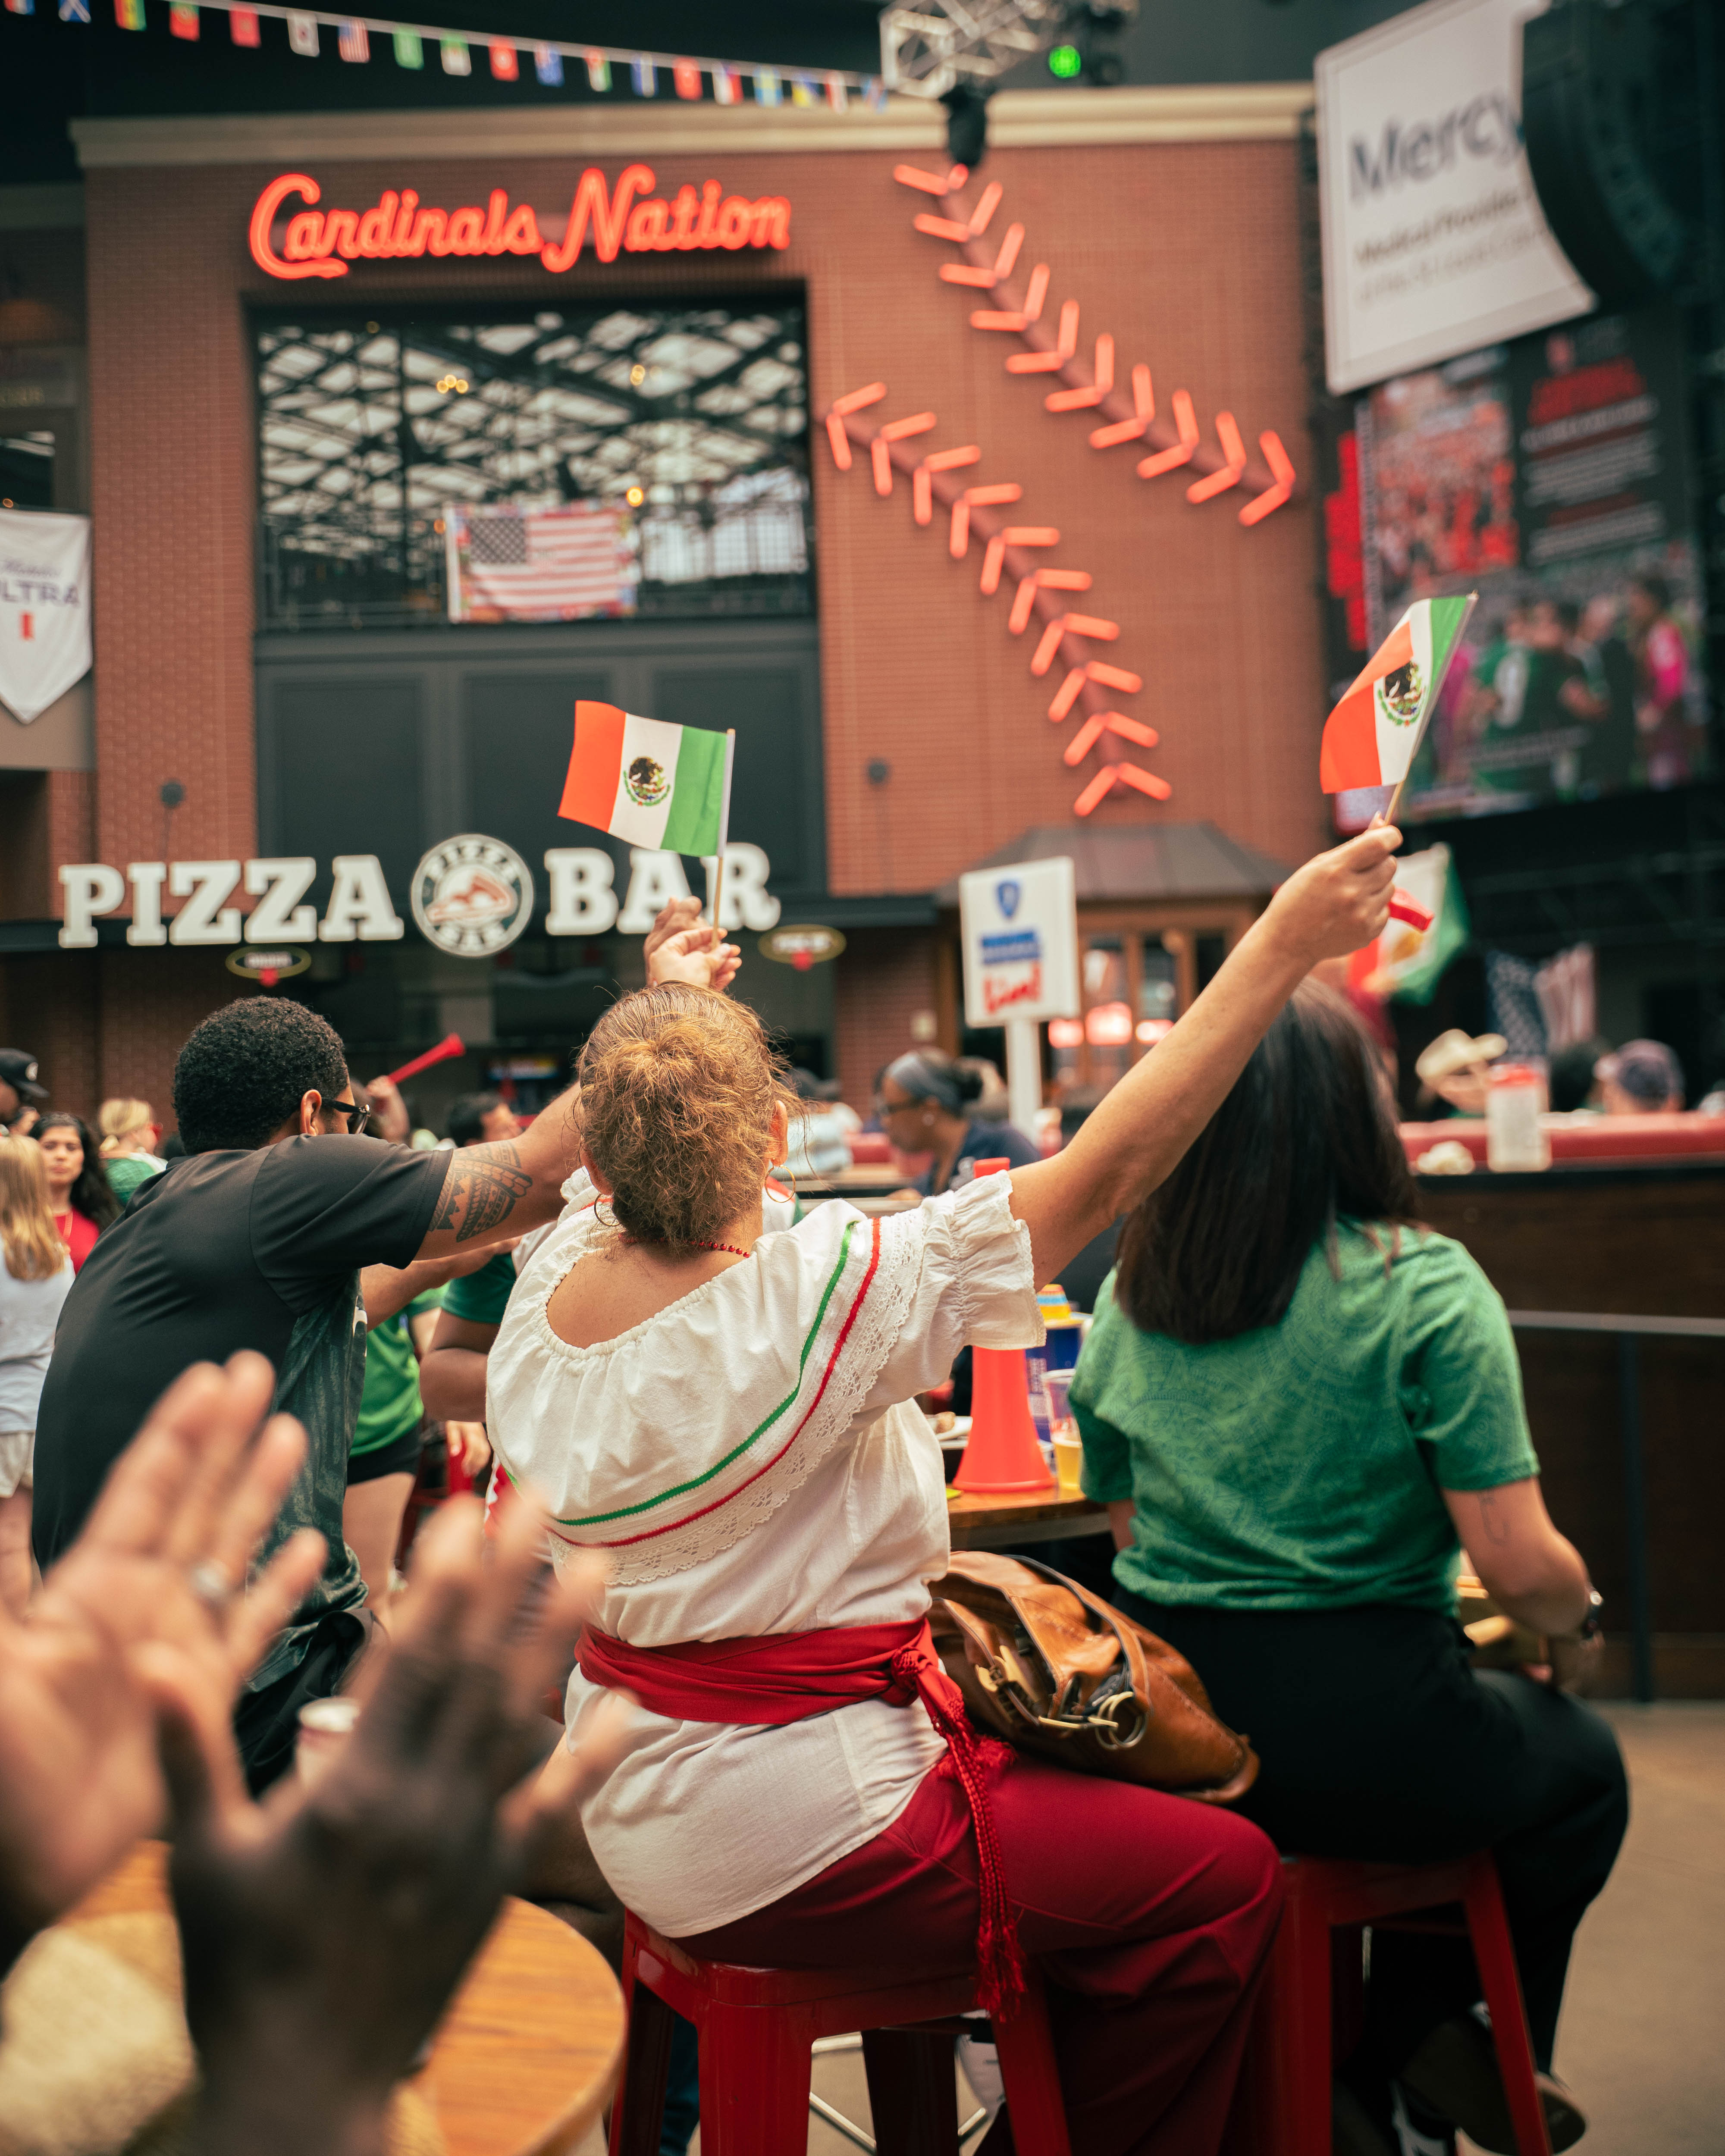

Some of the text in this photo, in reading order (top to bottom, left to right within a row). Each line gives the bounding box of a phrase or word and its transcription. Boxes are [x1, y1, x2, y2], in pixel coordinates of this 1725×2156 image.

[1350, 91, 1524, 205] Mercy
[249, 165, 790, 279] Cardinals Nation
[58, 855, 404, 948] PIZZA
[544, 842, 781, 936] BAR
